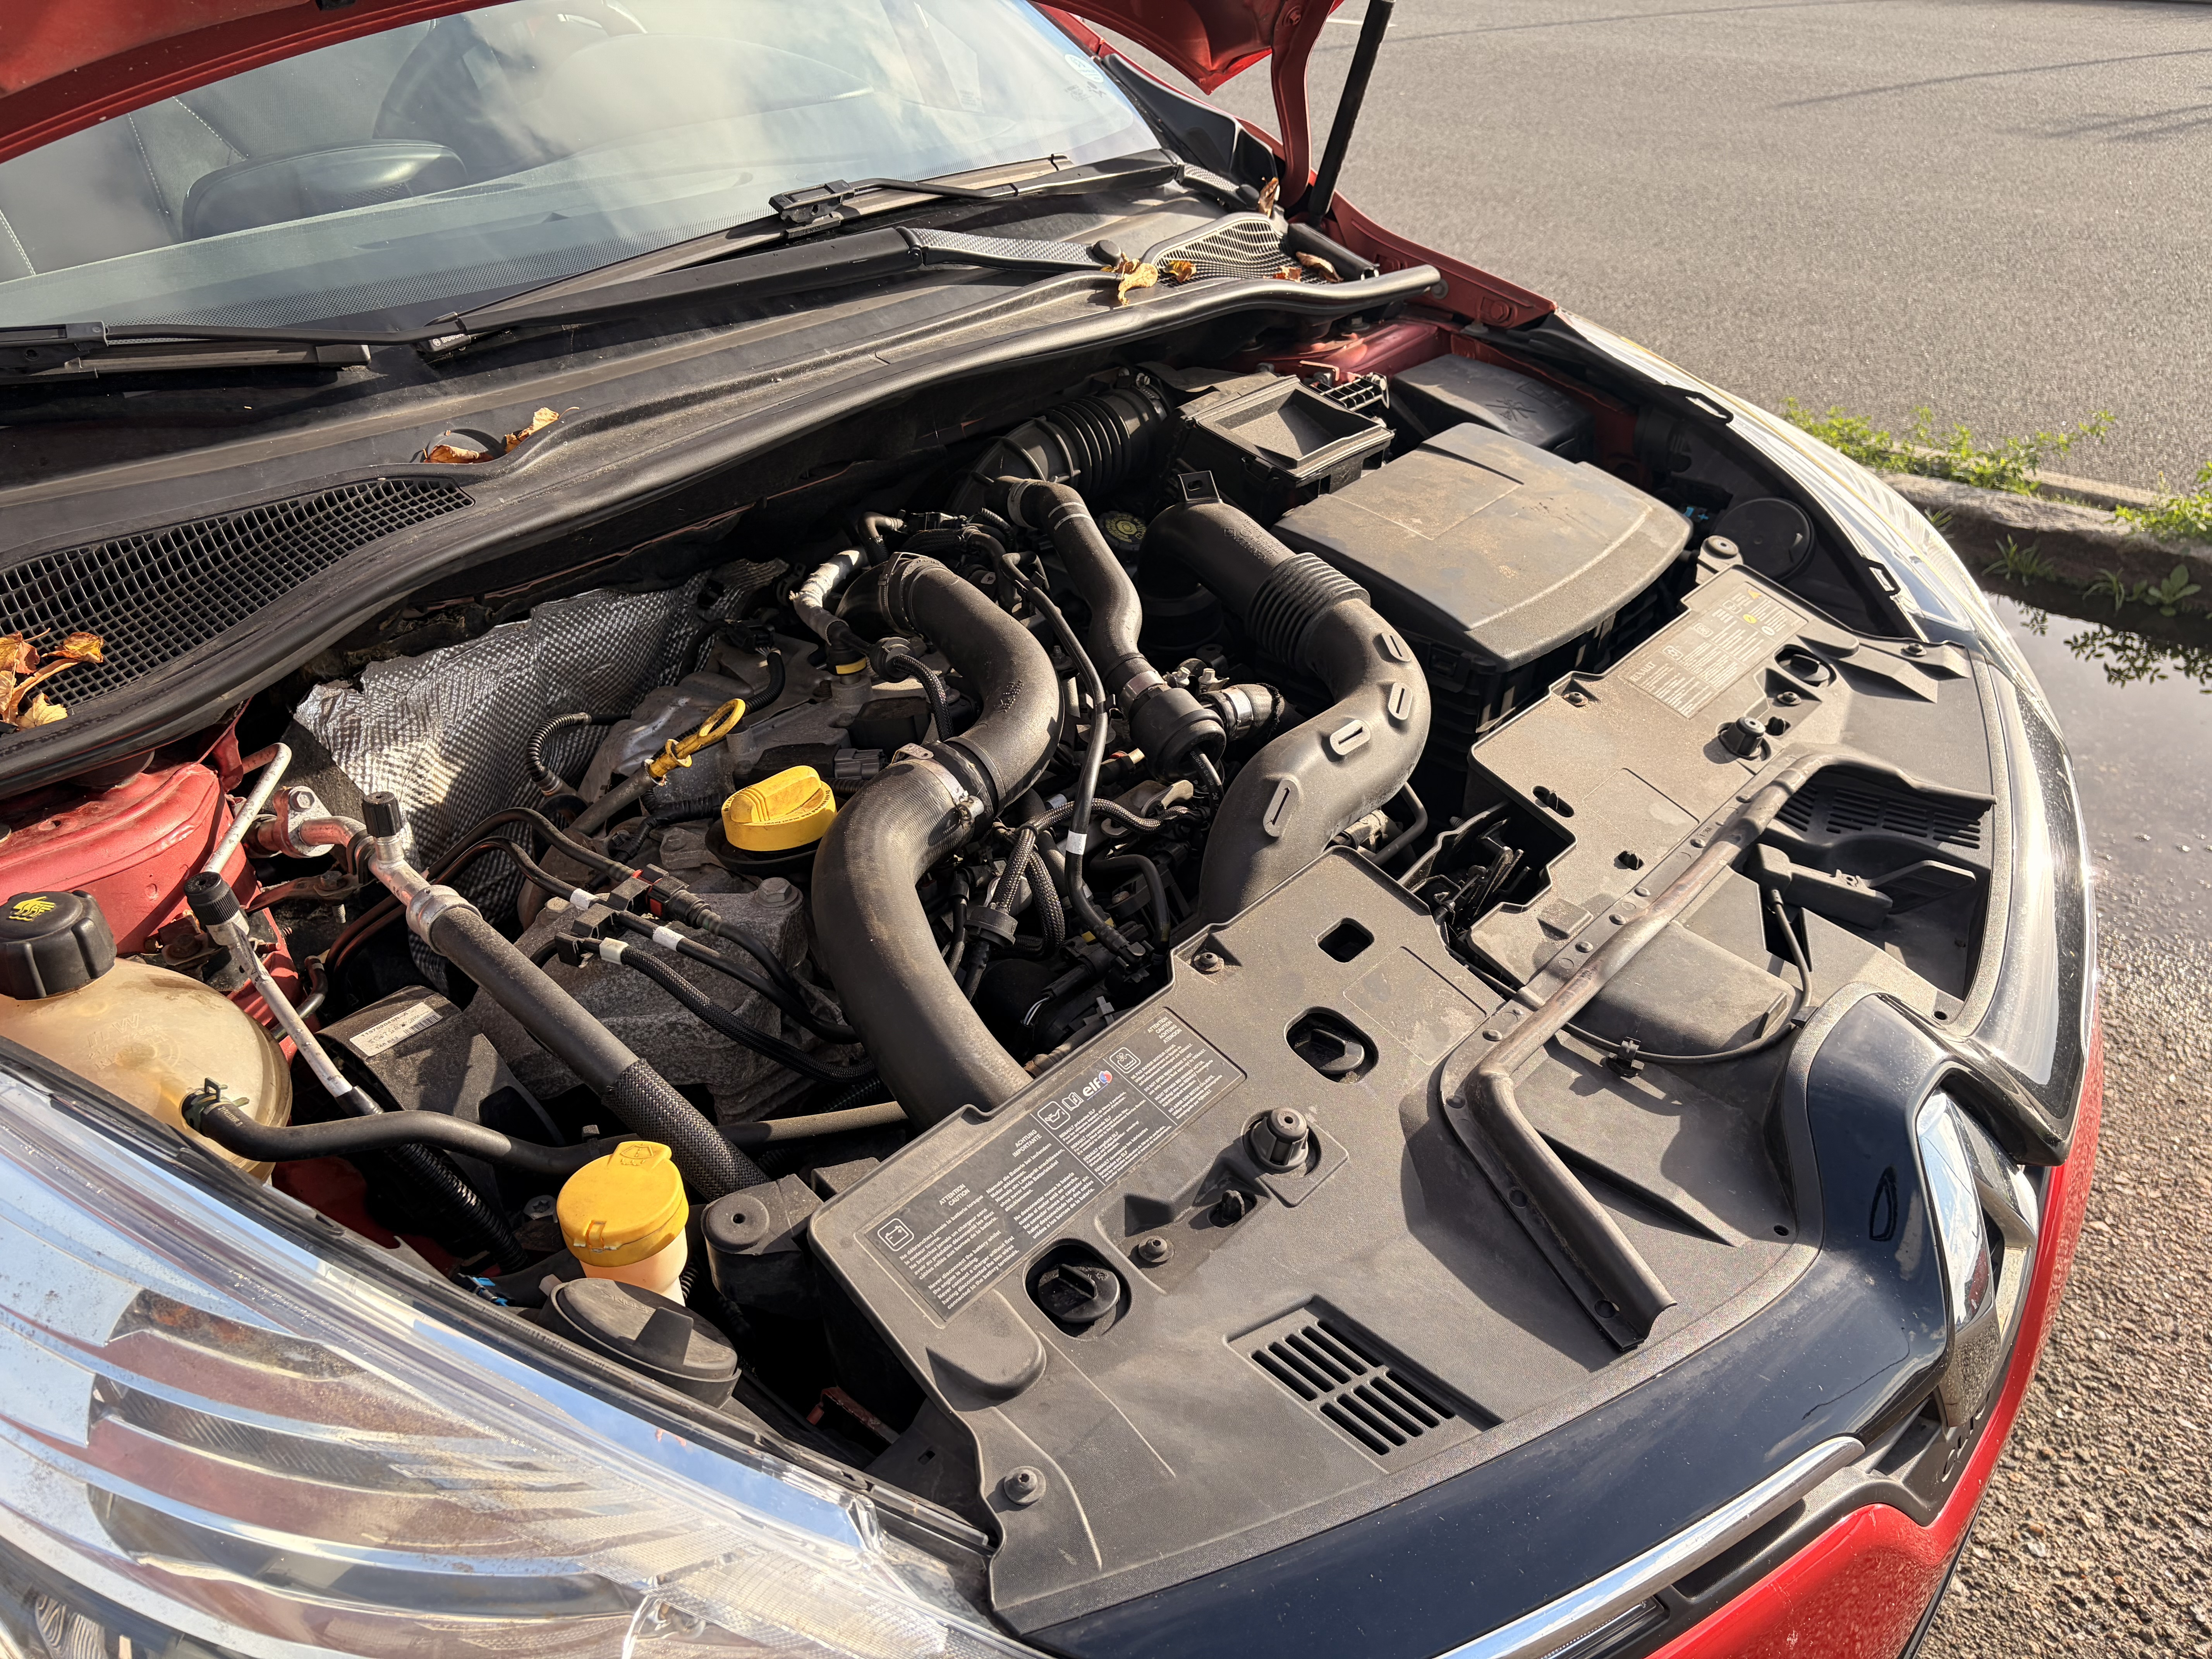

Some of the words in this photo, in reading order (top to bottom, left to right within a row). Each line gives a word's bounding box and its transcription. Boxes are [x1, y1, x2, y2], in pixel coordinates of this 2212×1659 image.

[1629, 661, 1656, 682] RENAULT
[1147, 1016, 1168, 1033] ATTENTION
[1156, 1020, 1173, 1034] CAUTION
[1158, 1024, 1177, 1039] ACHTUNG
[1082, 1077, 1102, 1097] elf
[1012, 1133, 1042, 1158] IMPORTANTE
[1015, 1129, 1037, 1148] ACHTUNG
[986, 1180, 1003, 1194] Niemals
[1008, 1163, 1025, 1177] Batterie
[990, 1187, 1003, 1198] Motor
[1003, 1171, 1027, 1189] abklemmen.
[995, 1188, 1013, 1202] Niemals
[1038, 1149, 1065, 1170] anschliessen,
[1000, 1198, 1011, 1207] ohne
[1010, 1188, 1022, 1199] zuvor
[1021, 1180, 1034, 1190] beide
[1032, 1159, 1059, 1182] Batteriekabel
[939, 1183, 966, 1206] ATTENTION
[948, 1188, 970, 1206] CAUTION
[1005, 1189, 1034, 1212] abzuklemmen.
[1018, 1212, 1034, 1225] cuando
[1037, 1199, 1050, 1210] motor
[1049, 1192, 1059, 1201] está
[1063, 1177, 1079, 1190] marcha.
[1020, 1195, 1044, 1216] desconectar
[1044, 1186, 1057, 1197] nunca
[1027, 1223, 1040, 1235] haber
[1039, 1202, 1067, 1225] desconectado
[1080, 1180, 1094, 1192] cables
[1030, 1209, 1047, 1224] conectar
[1047, 1199, 1060, 1211] nunca
[1065, 1180, 1083, 1196] cargador
[907, 1234, 933, 1255] débranchez
[931, 1223, 947, 1237] jamais
[950, 1207, 968, 1221] batterie
[967, 1195, 984, 1209] lorsque
[916, 1247, 938, 1264] branchez
[936, 1236, 952, 1250] jamais
[958, 1216, 977, 1232] chargeur
[976, 1208, 988, 1218] sans
[946, 1249, 956, 1258] aux
[954, 1238, 970, 1251] bornes
[980, 1217, 998, 1231] batterie.
[1032, 1226, 1047, 1239] unidos
[1055, 1207, 1070, 1220] bornes
[909, 1247, 926, 1262] moteur
[925, 1237, 941, 1249] tourne.
[914, 1264, 926, 1275] avoir
[932, 1243, 953, 1262] préalable
[952, 1224, 977, 1245] déconnecté
[983, 1211, 994, 1220] deux
[928, 1278, 942, 1290] Never
[942, 1258, 967, 1279] disconnect
[972, 1240, 988, 1254] battery
[988, 1230, 1001, 1242] whilst
[937, 1286, 951, 1300] Never
[951, 1271, 970, 1288] connect
[973, 1255, 989, 1271] charger
[989, 1243, 1006, 1257] without
[1004, 1236, 1015, 1245] first
[941, 1275, 956, 1288] engine
[960, 1257, 979, 1272] running.
[941, 1290, 959, 1305] having
[958, 1266, 987, 1292] disconnected
[993, 1254, 1003, 1262] two
[1001, 1245, 1014, 1255] wires
[947, 1288, 971, 1309] connected
[982, 1265, 999, 1279] battery
[998, 1250, 1019, 1267] terminals.
